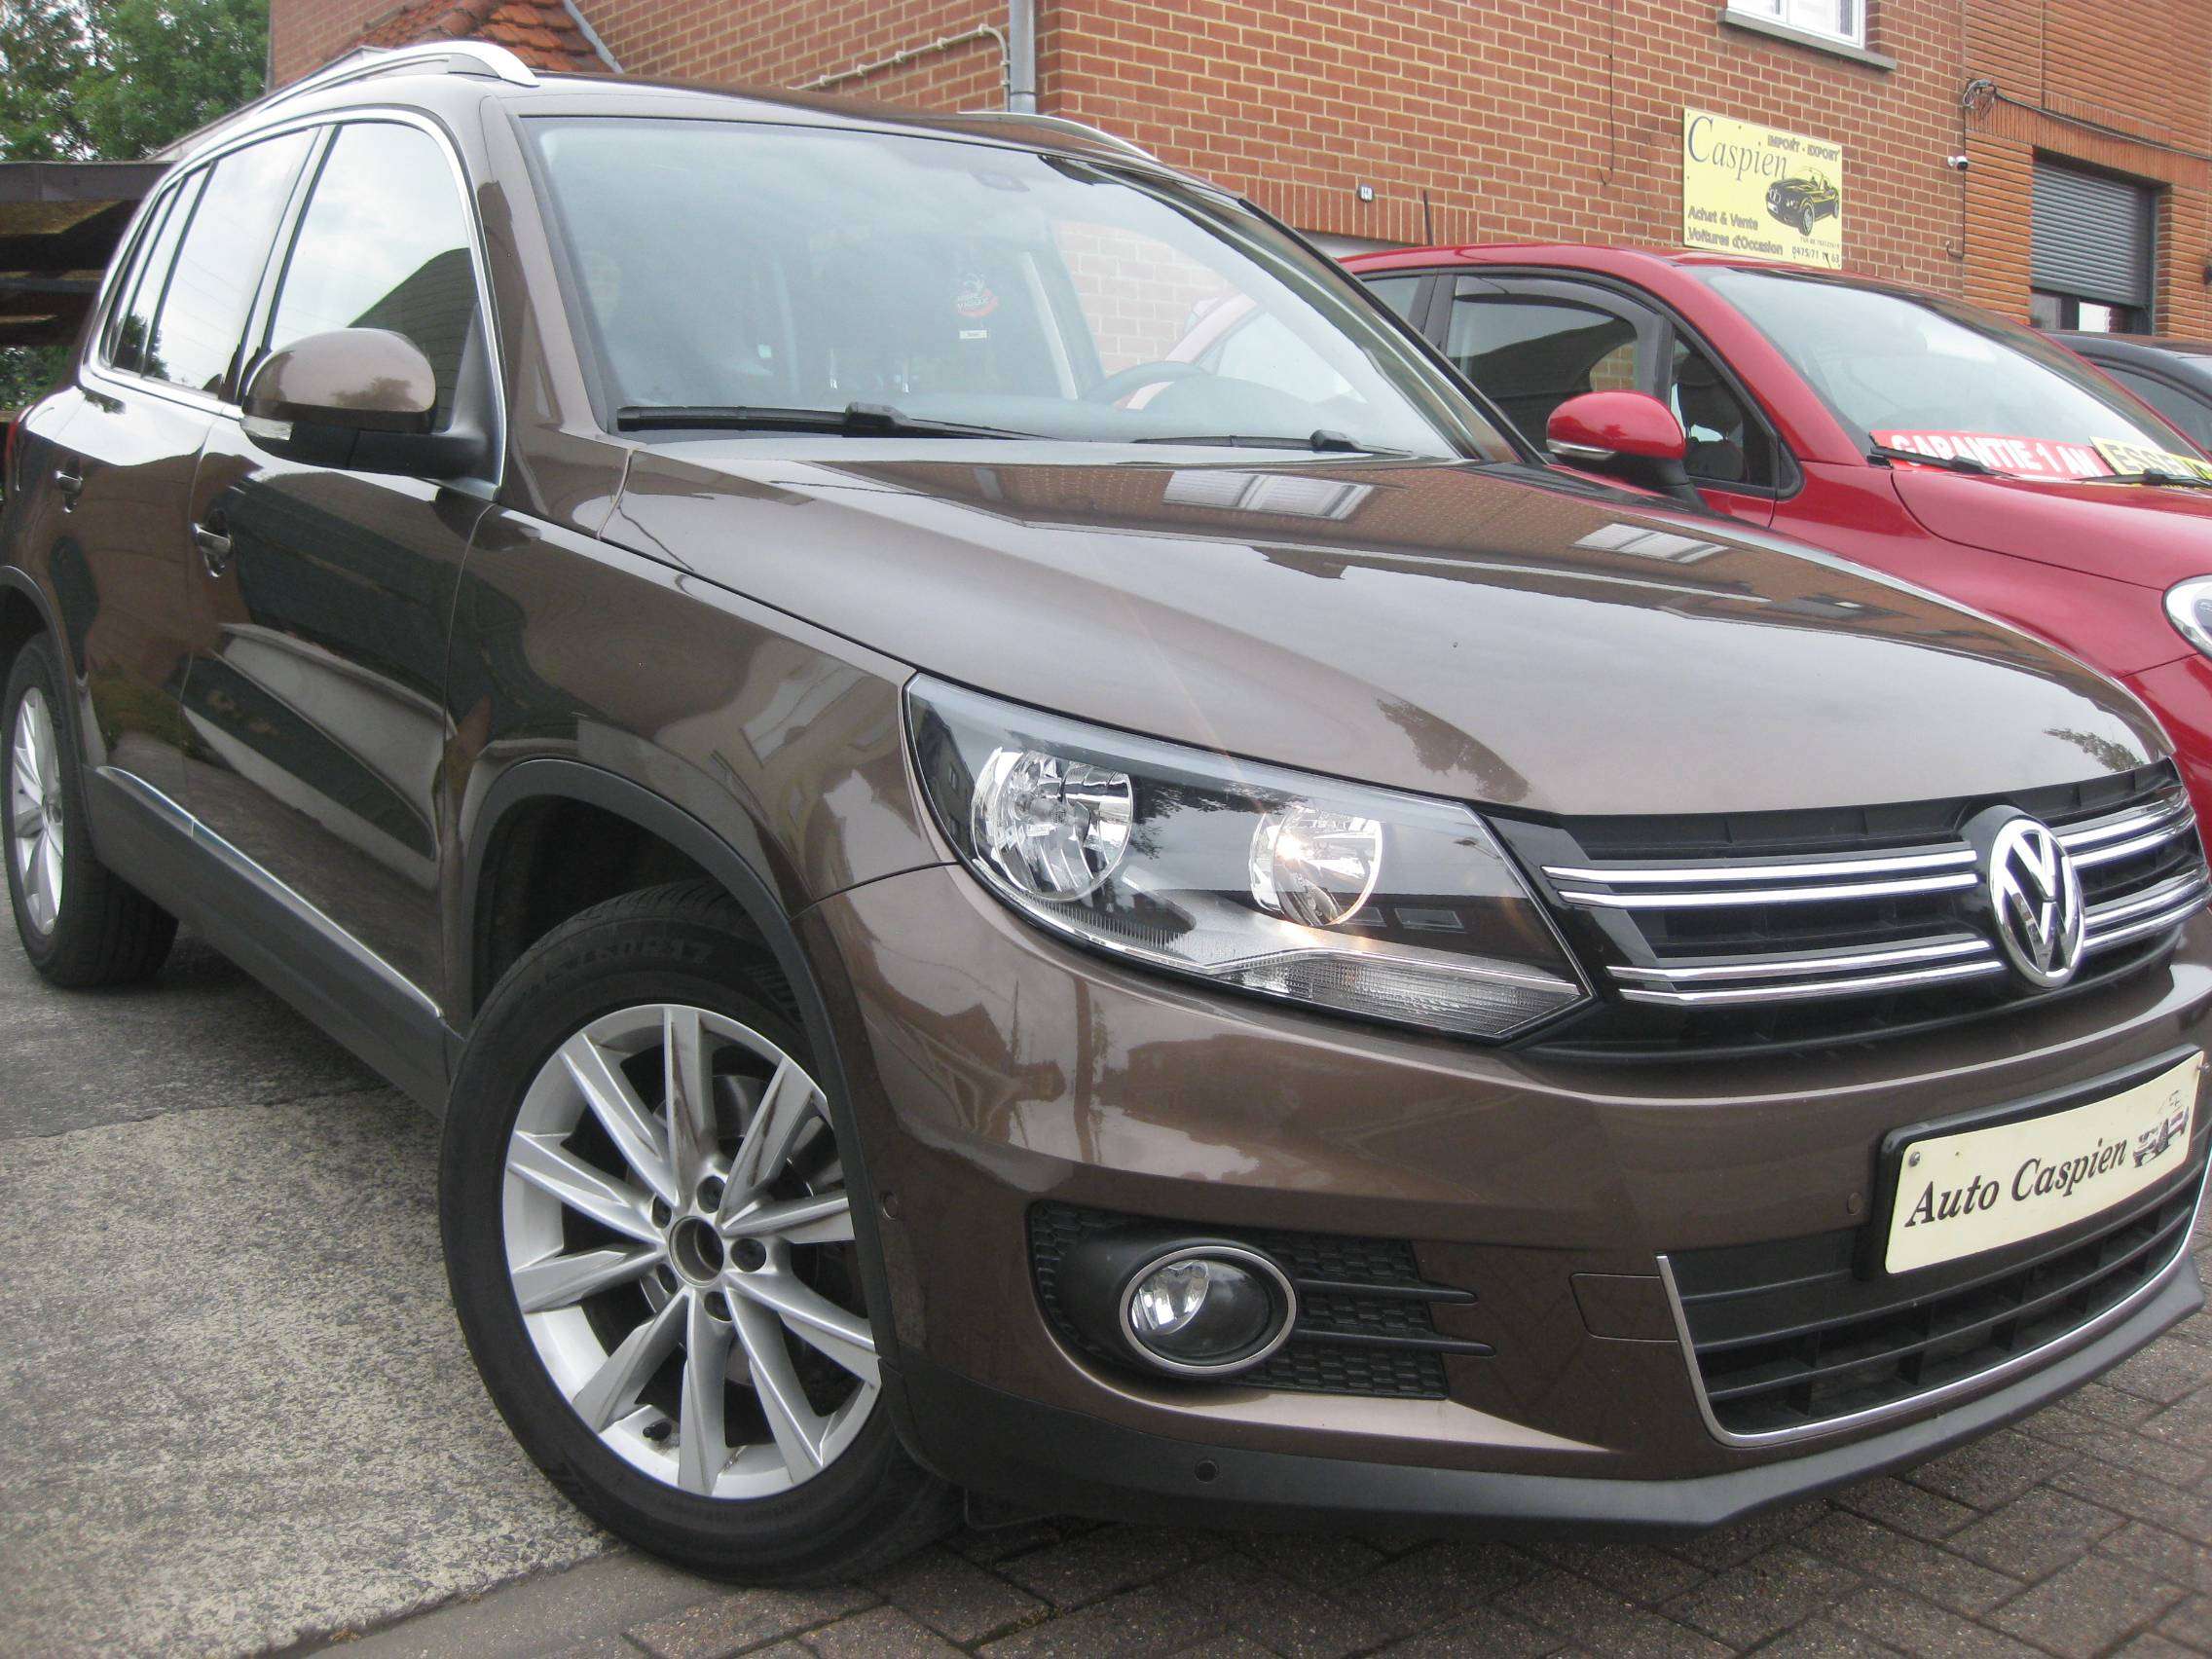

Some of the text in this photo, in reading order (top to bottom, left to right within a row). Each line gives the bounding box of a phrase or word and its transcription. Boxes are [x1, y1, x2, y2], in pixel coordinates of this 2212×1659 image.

[1687, 115, 1788, 181] Caspien
[1768, 134, 1800, 153] IMPORT
[1807, 144, 1840, 162] EXPORT
[1719, 211, 1728, 225] &
[1730, 213, 1758, 231] Vente
[1688, 226, 1729, 246] Voitures
[2056, 446, 2103, 477] AN
[1904, 1137, 2126, 1228] Auto Caspien
